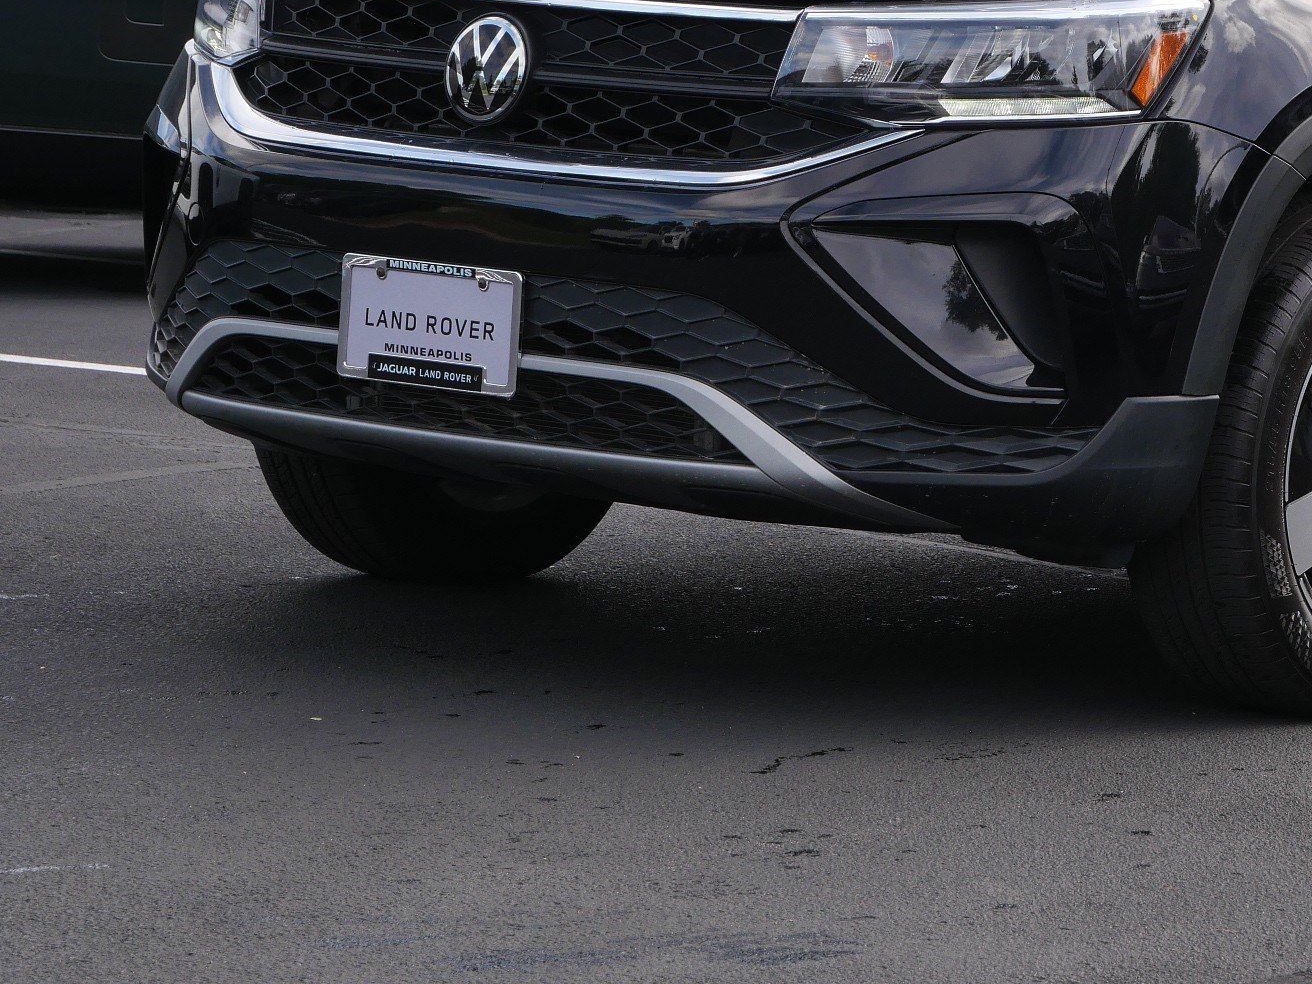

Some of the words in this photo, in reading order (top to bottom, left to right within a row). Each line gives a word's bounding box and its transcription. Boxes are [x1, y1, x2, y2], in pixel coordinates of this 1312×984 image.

[389, 259, 473, 278] MINNEAPOLIS
[364, 307, 417, 331] LAND
[425, 315, 495, 341] ROVER
[384, 342, 473, 362] MINNEAPOLIS
[377, 362, 417, 376] JAGUAR
[419, 368, 441, 379] LAND
[443, 371, 472, 384] ROVER
